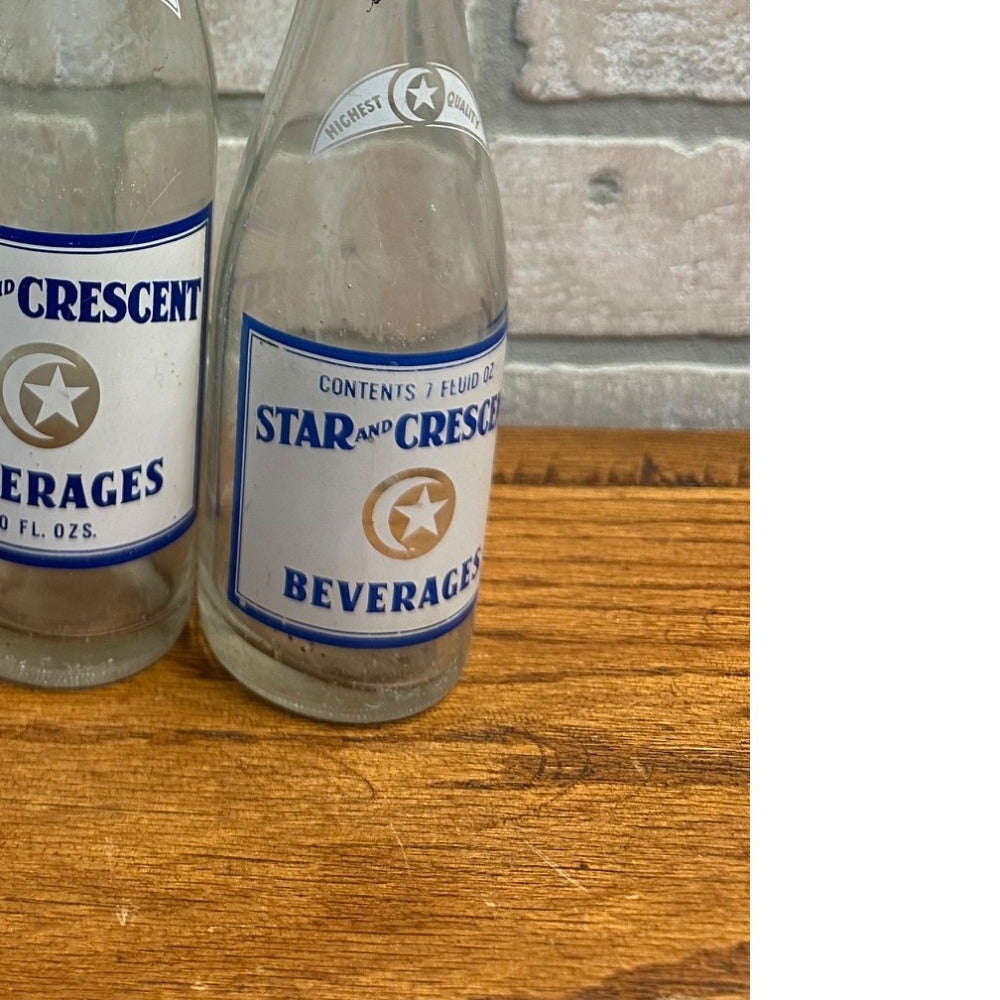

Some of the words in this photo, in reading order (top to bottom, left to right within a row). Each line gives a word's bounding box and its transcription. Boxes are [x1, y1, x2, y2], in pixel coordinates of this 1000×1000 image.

[324, 94, 383, 141] HIGHEST
[17, 276, 202, 324] CRESCENT
[319, 374, 416, 401] CONTENTS
[426, 382, 433, 398] 7
[441, 371, 479, 398] FLUID
[256, 404, 357, 450] STAR
[355, 419, 393, 443] AND
[395, 391, 501, 450] CRESCE
[20, 519, 45, 539] FL.
[54, 522, 97, 539] OZS.
[284, 546, 481, 613] BEVERAGES
